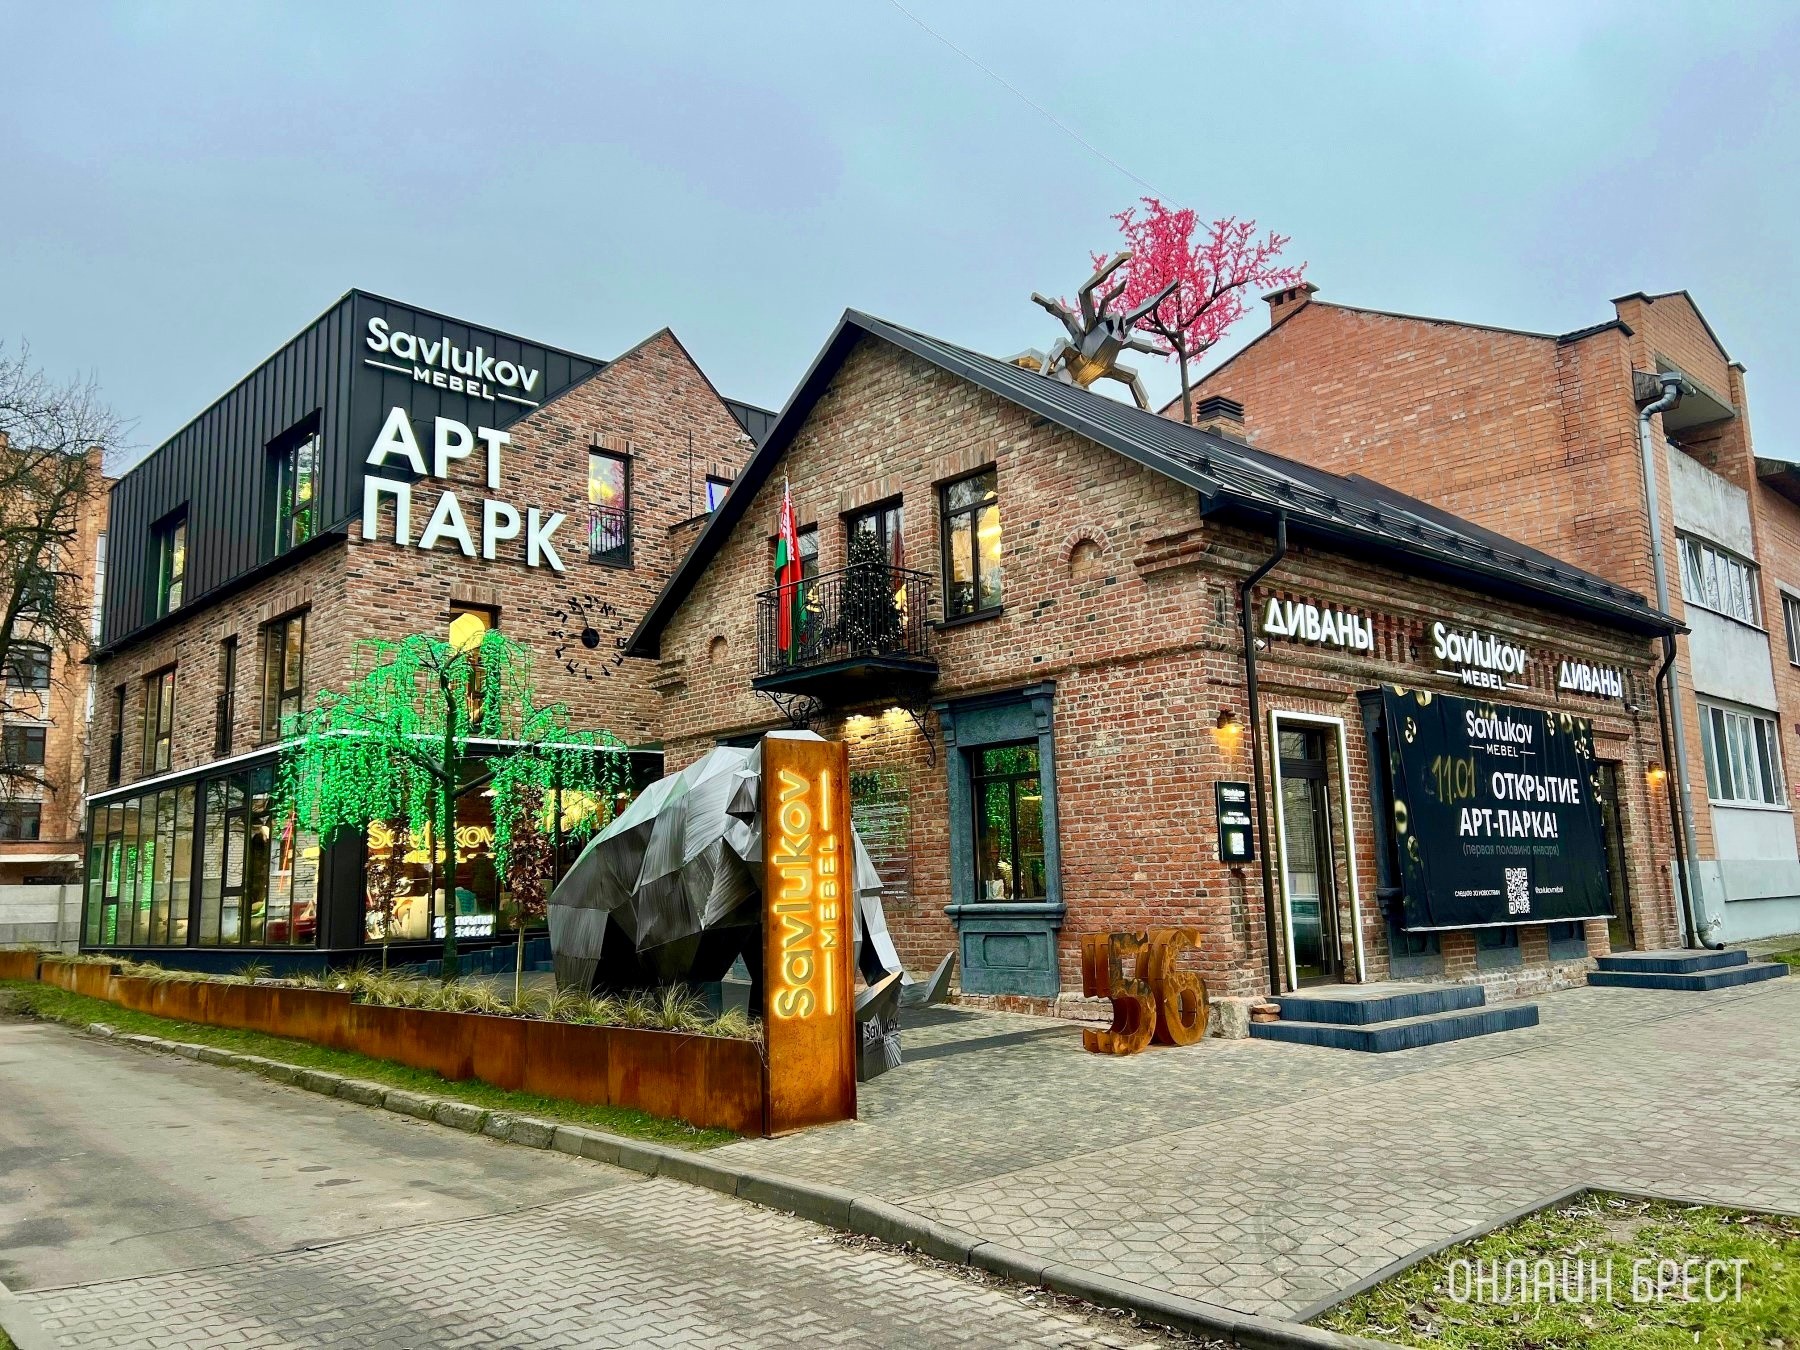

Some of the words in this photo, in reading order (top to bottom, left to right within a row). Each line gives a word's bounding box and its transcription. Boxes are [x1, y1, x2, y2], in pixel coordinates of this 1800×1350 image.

[366, 317, 539, 392] Savlukov
[413, 365, 495, 401] MEBEL
[366, 406, 511, 489] АРТ
[362, 474, 567, 571] ПАРК
[1264, 597, 1375, 651] ДИВАНЫ
[1433, 621, 1526, 675] Savlukov
[1461, 668, 1507, 691] MEBEL
[1559, 660, 1624, 698] ДИВАНЫ
[1465, 709, 1533, 744] Savlukov
[1486, 743, 1519, 758] MEBEL
[1492, 771, 1580, 804] ОТКРЫТИЕ
[1459, 807, 1559, 838] АРТ-ПАРКА!
[775, 770, 815, 1018] Savlukov
[818, 834, 838, 949] MEBEL
[1081, 927, 1209, 1056] 56
